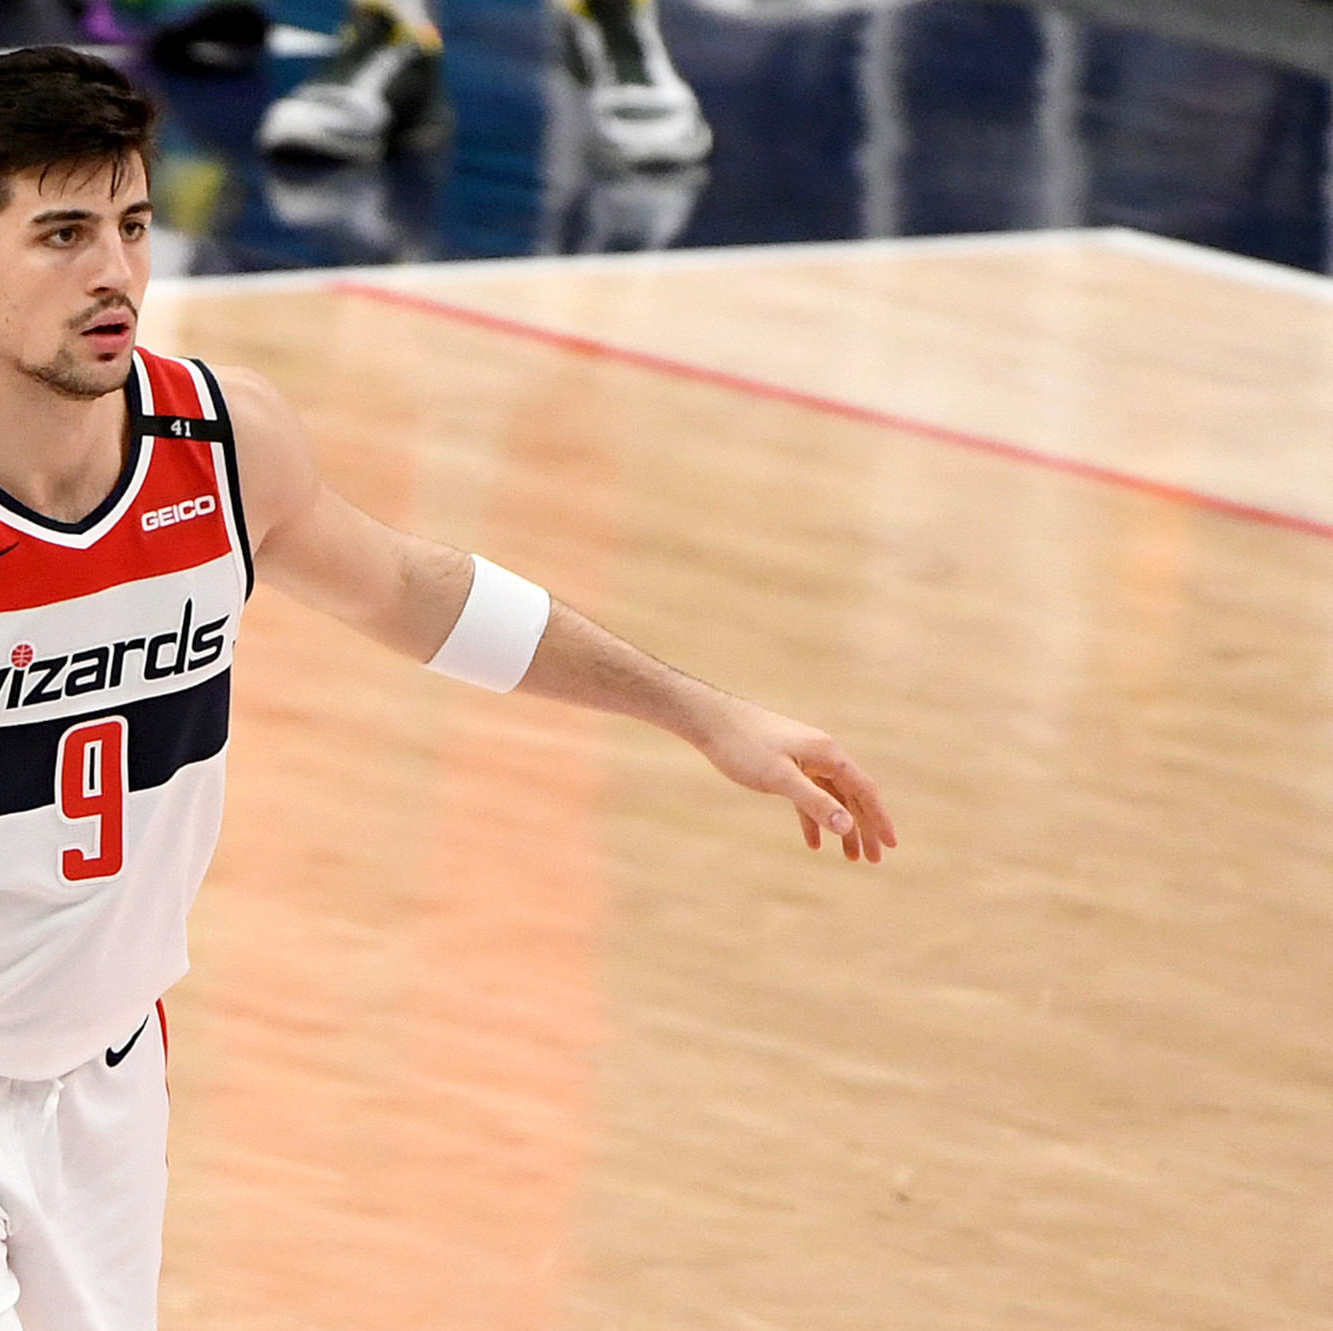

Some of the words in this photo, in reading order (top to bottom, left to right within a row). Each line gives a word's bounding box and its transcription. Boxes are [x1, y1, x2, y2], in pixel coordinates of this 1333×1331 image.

[169, 419, 192, 438] 41
[140, 494, 216, 533] GEICO
[55, 715, 129, 886] 9
